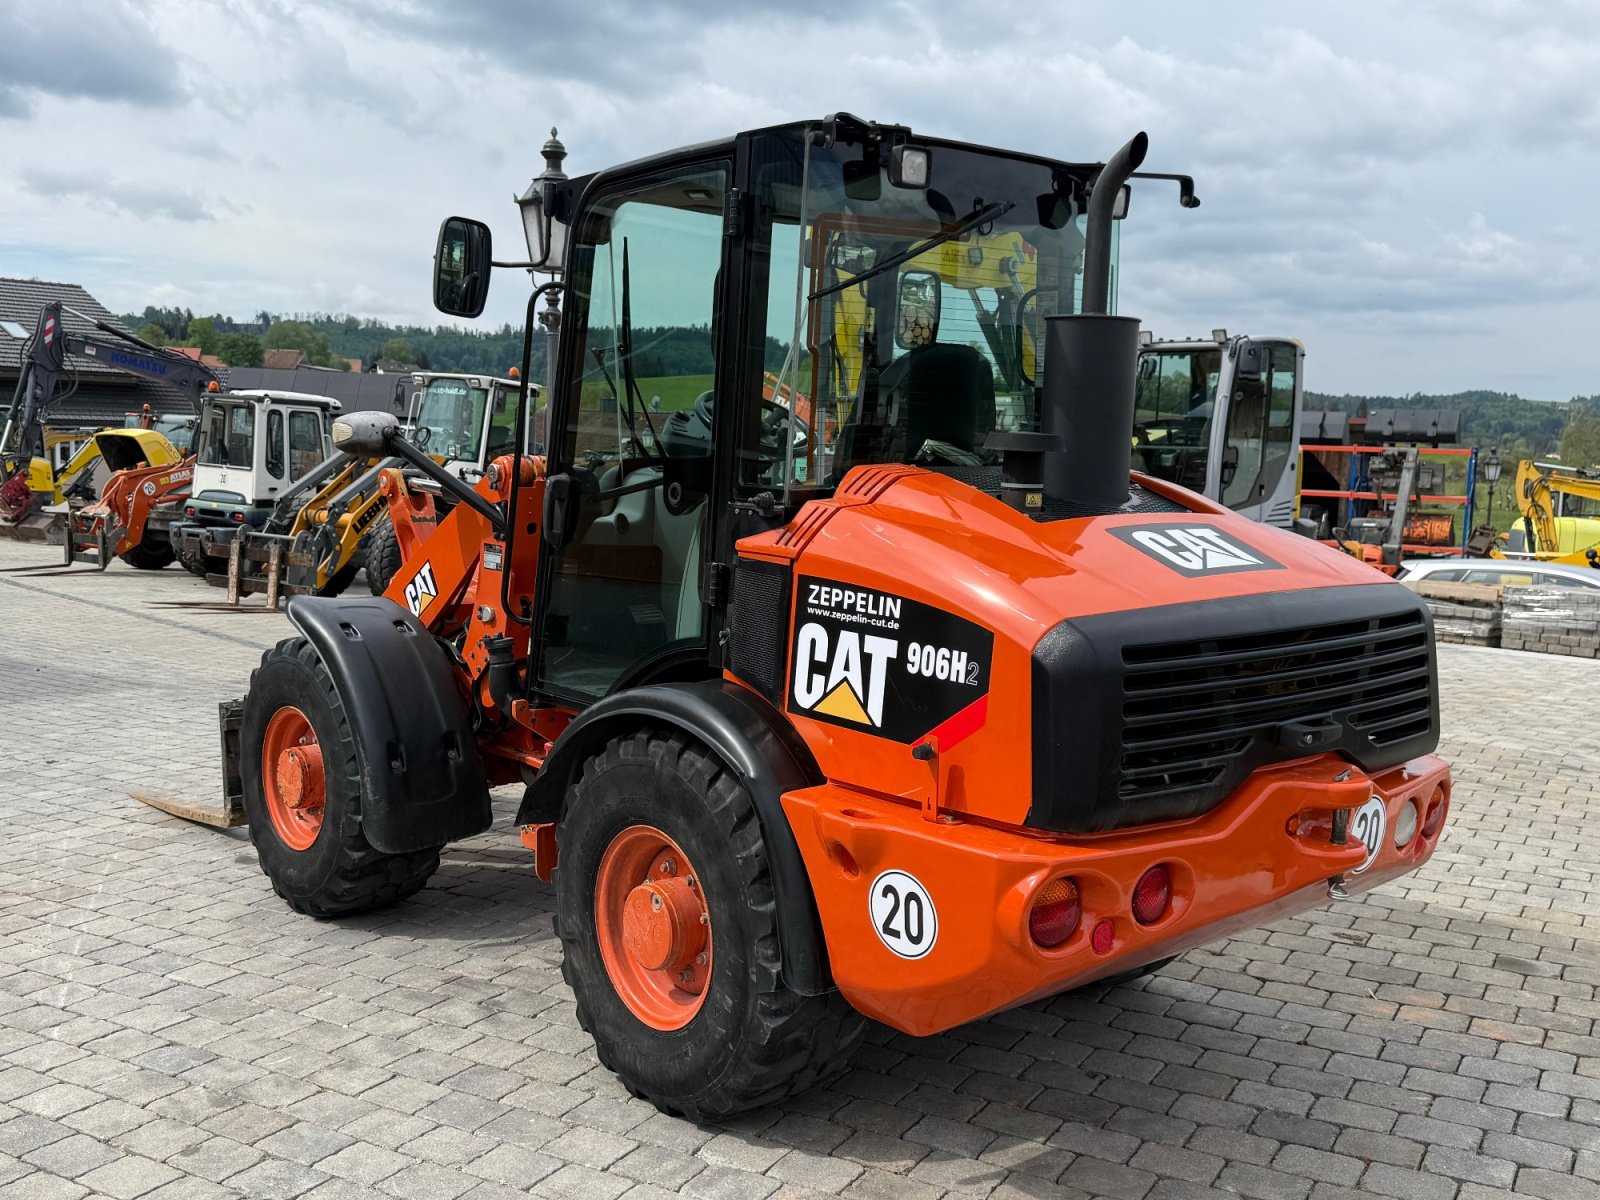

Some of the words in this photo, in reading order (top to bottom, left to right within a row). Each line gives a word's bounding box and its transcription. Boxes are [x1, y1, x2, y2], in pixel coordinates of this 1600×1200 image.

[112, 352, 166, 374] KOMATSU
[145, 483, 155, 494] 20
[170, 469, 191, 482] ATLAS
[1131, 528, 1264, 570] CAT
[405, 561, 437, 618] CAT
[807, 584, 902, 619] ZEPPELIN
[807, 606, 900, 630] www.zeppelin-cut.de
[794, 622, 898, 728] CAT
[1357, 808, 1380, 857] 20
[880, 884, 924, 946] 20
